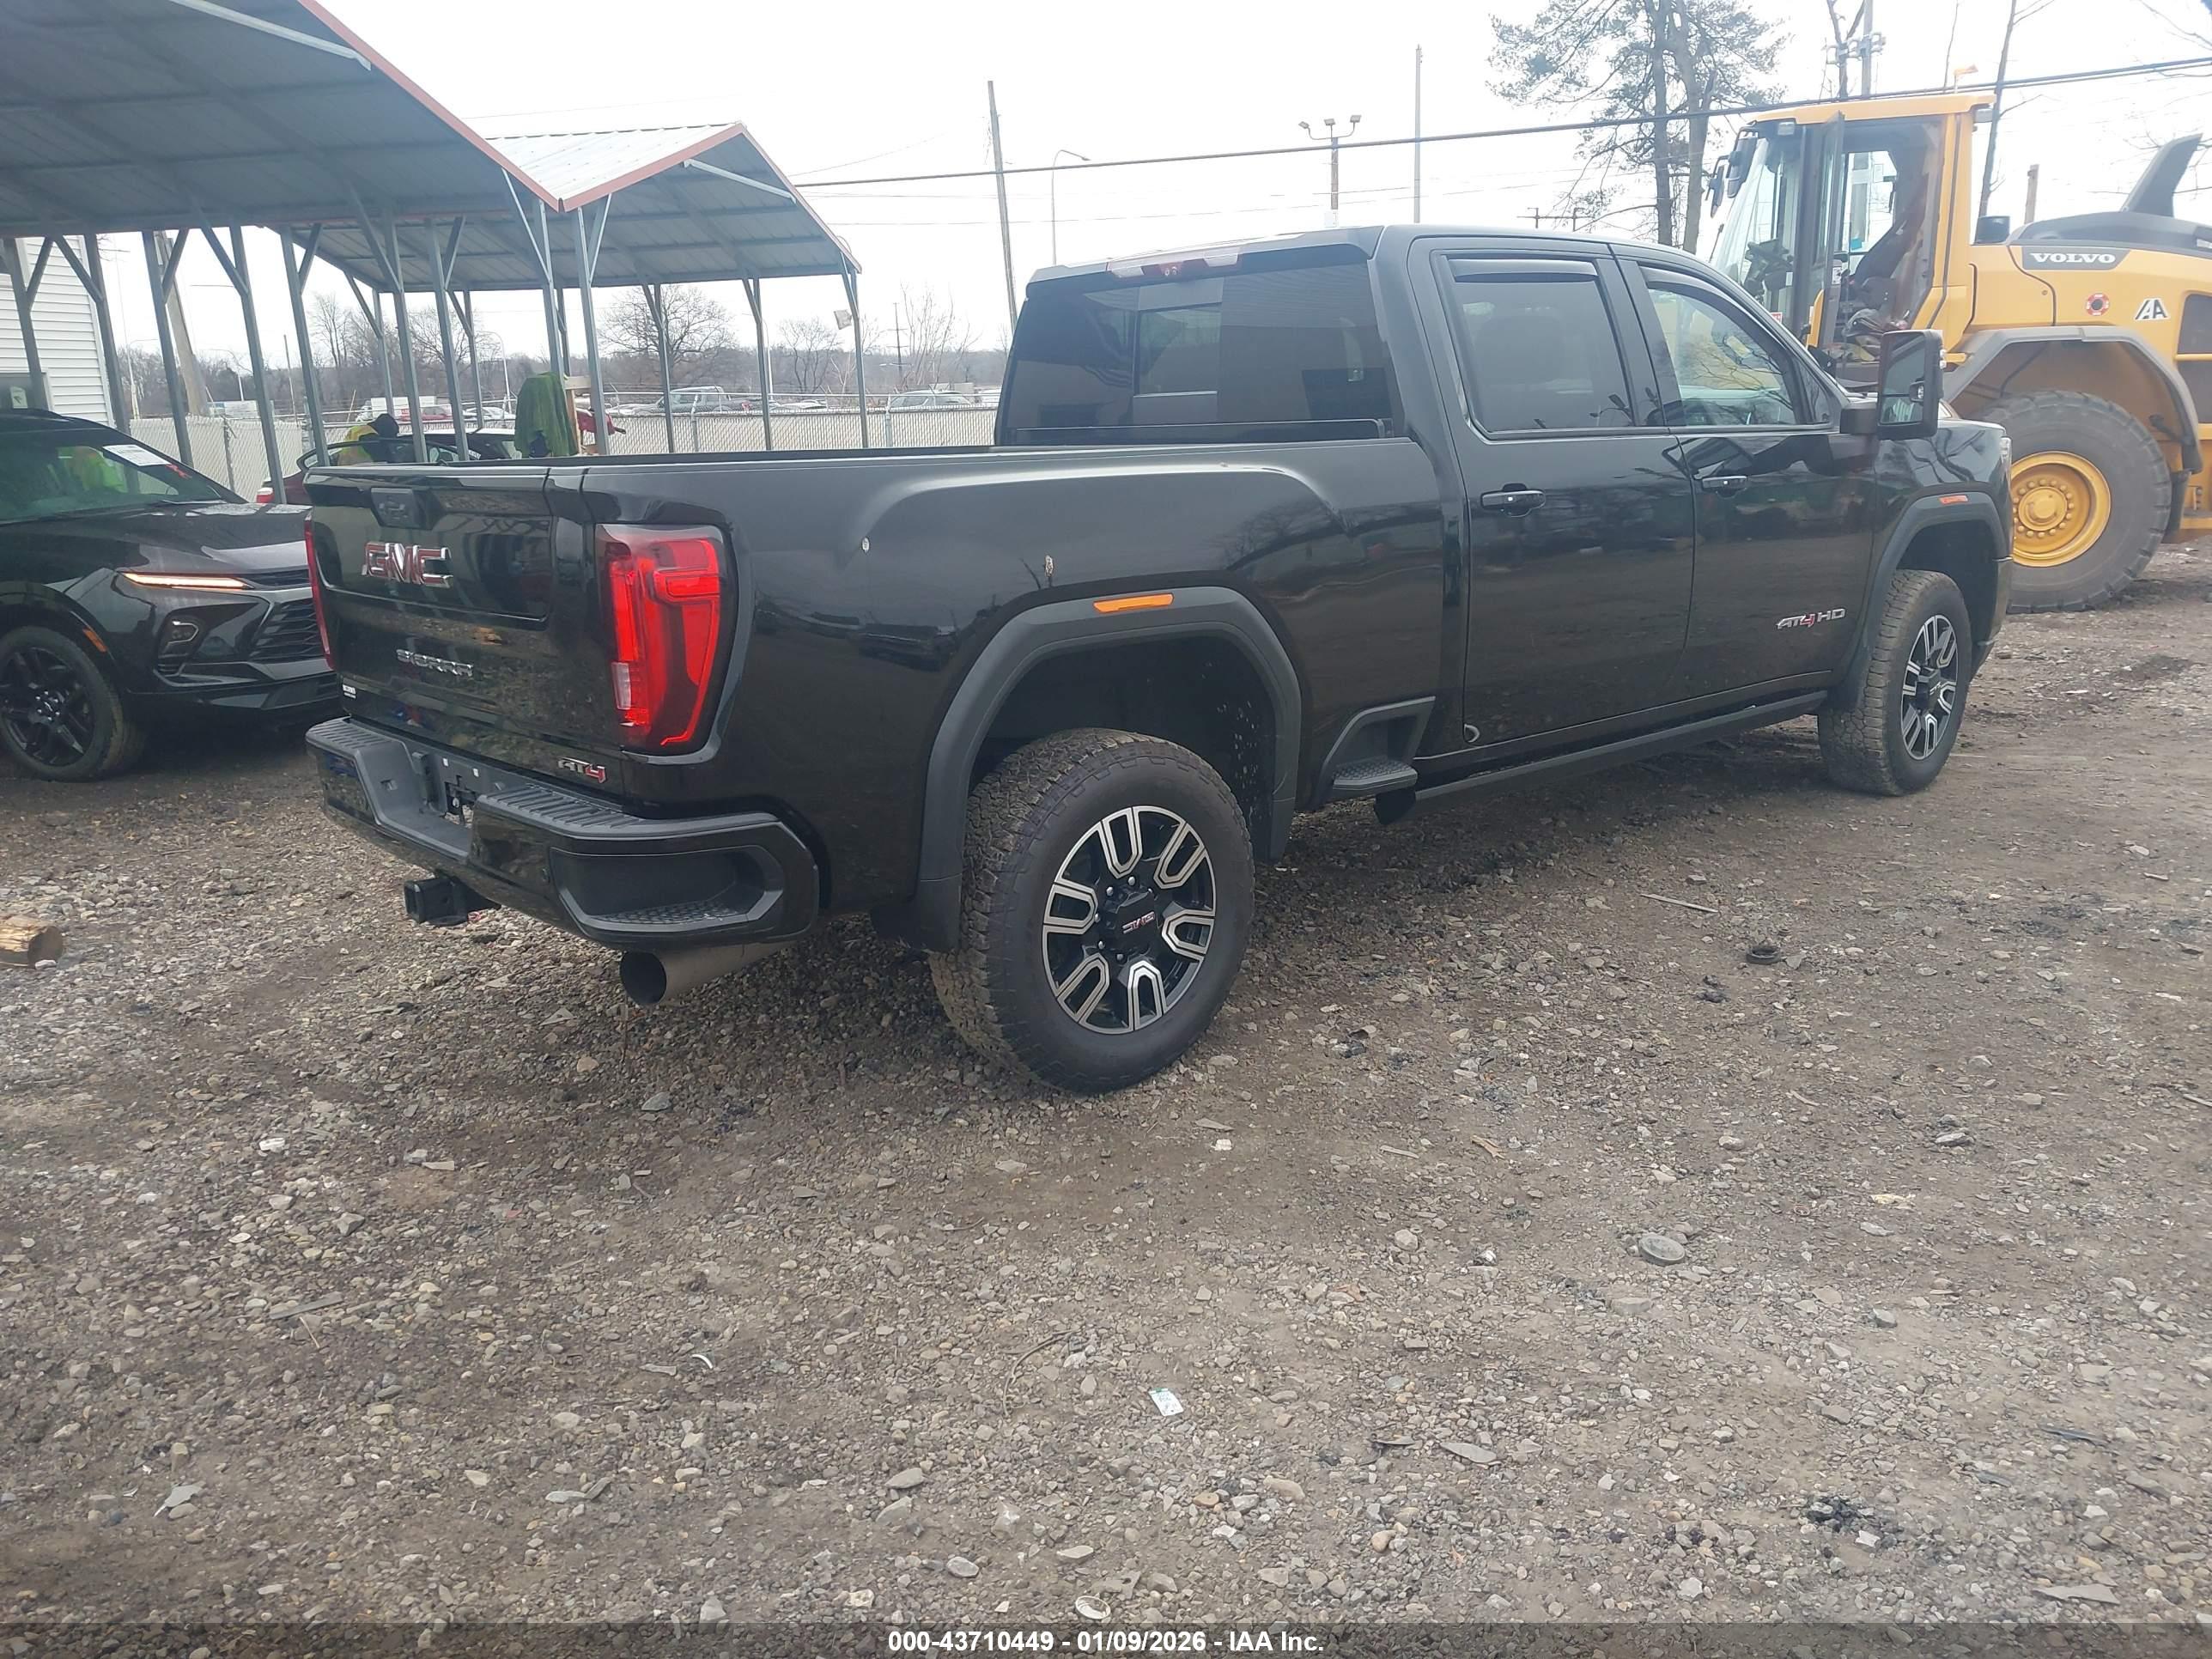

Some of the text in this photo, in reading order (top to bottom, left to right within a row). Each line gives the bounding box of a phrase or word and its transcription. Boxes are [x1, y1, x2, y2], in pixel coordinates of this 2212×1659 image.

[2030, 252, 2116, 264] VOLVO
[362, 541, 453, 588] GMC
[1775, 608, 1845, 629] AT4 HD
[558, 757, 606, 783] AT4
